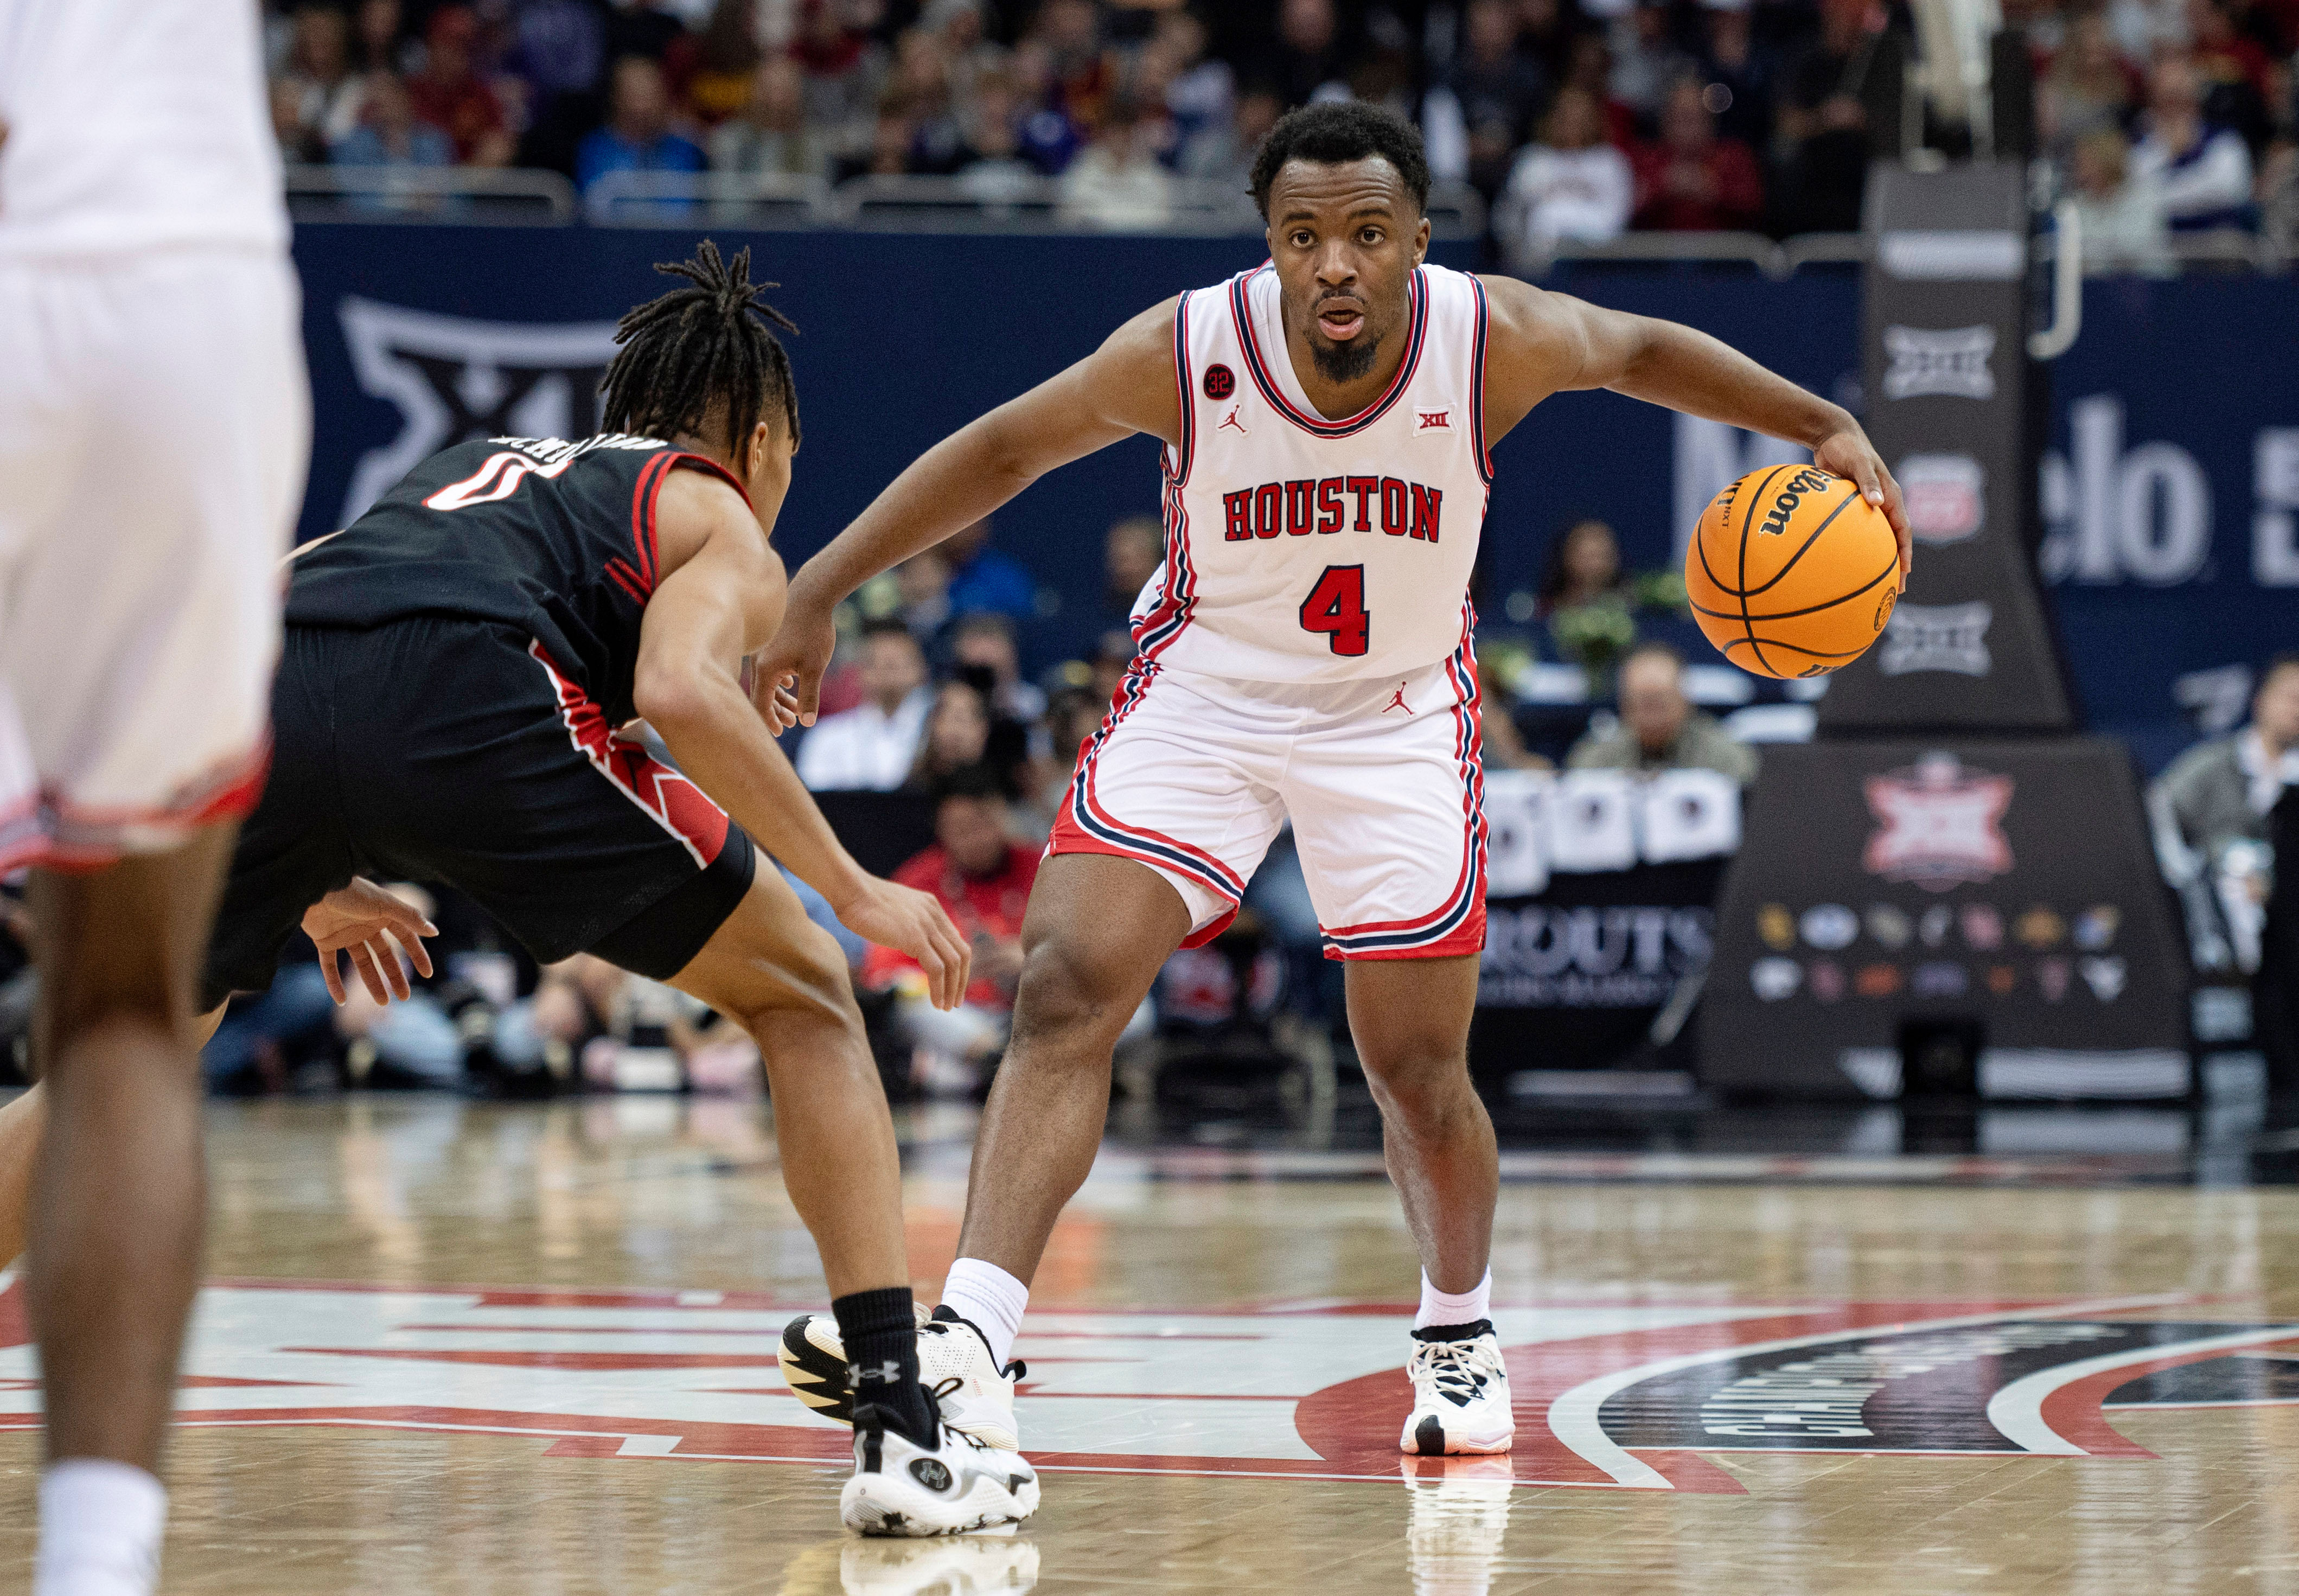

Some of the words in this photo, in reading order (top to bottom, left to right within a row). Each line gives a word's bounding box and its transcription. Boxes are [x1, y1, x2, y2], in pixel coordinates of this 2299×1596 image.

[1209, 372, 1229, 393] 32
[1419, 411, 1450, 429] XII
[1223, 475, 1442, 543] HOUSTON
[1722, 506, 1732, 529] NXT
[1299, 564, 1370, 657] 4
